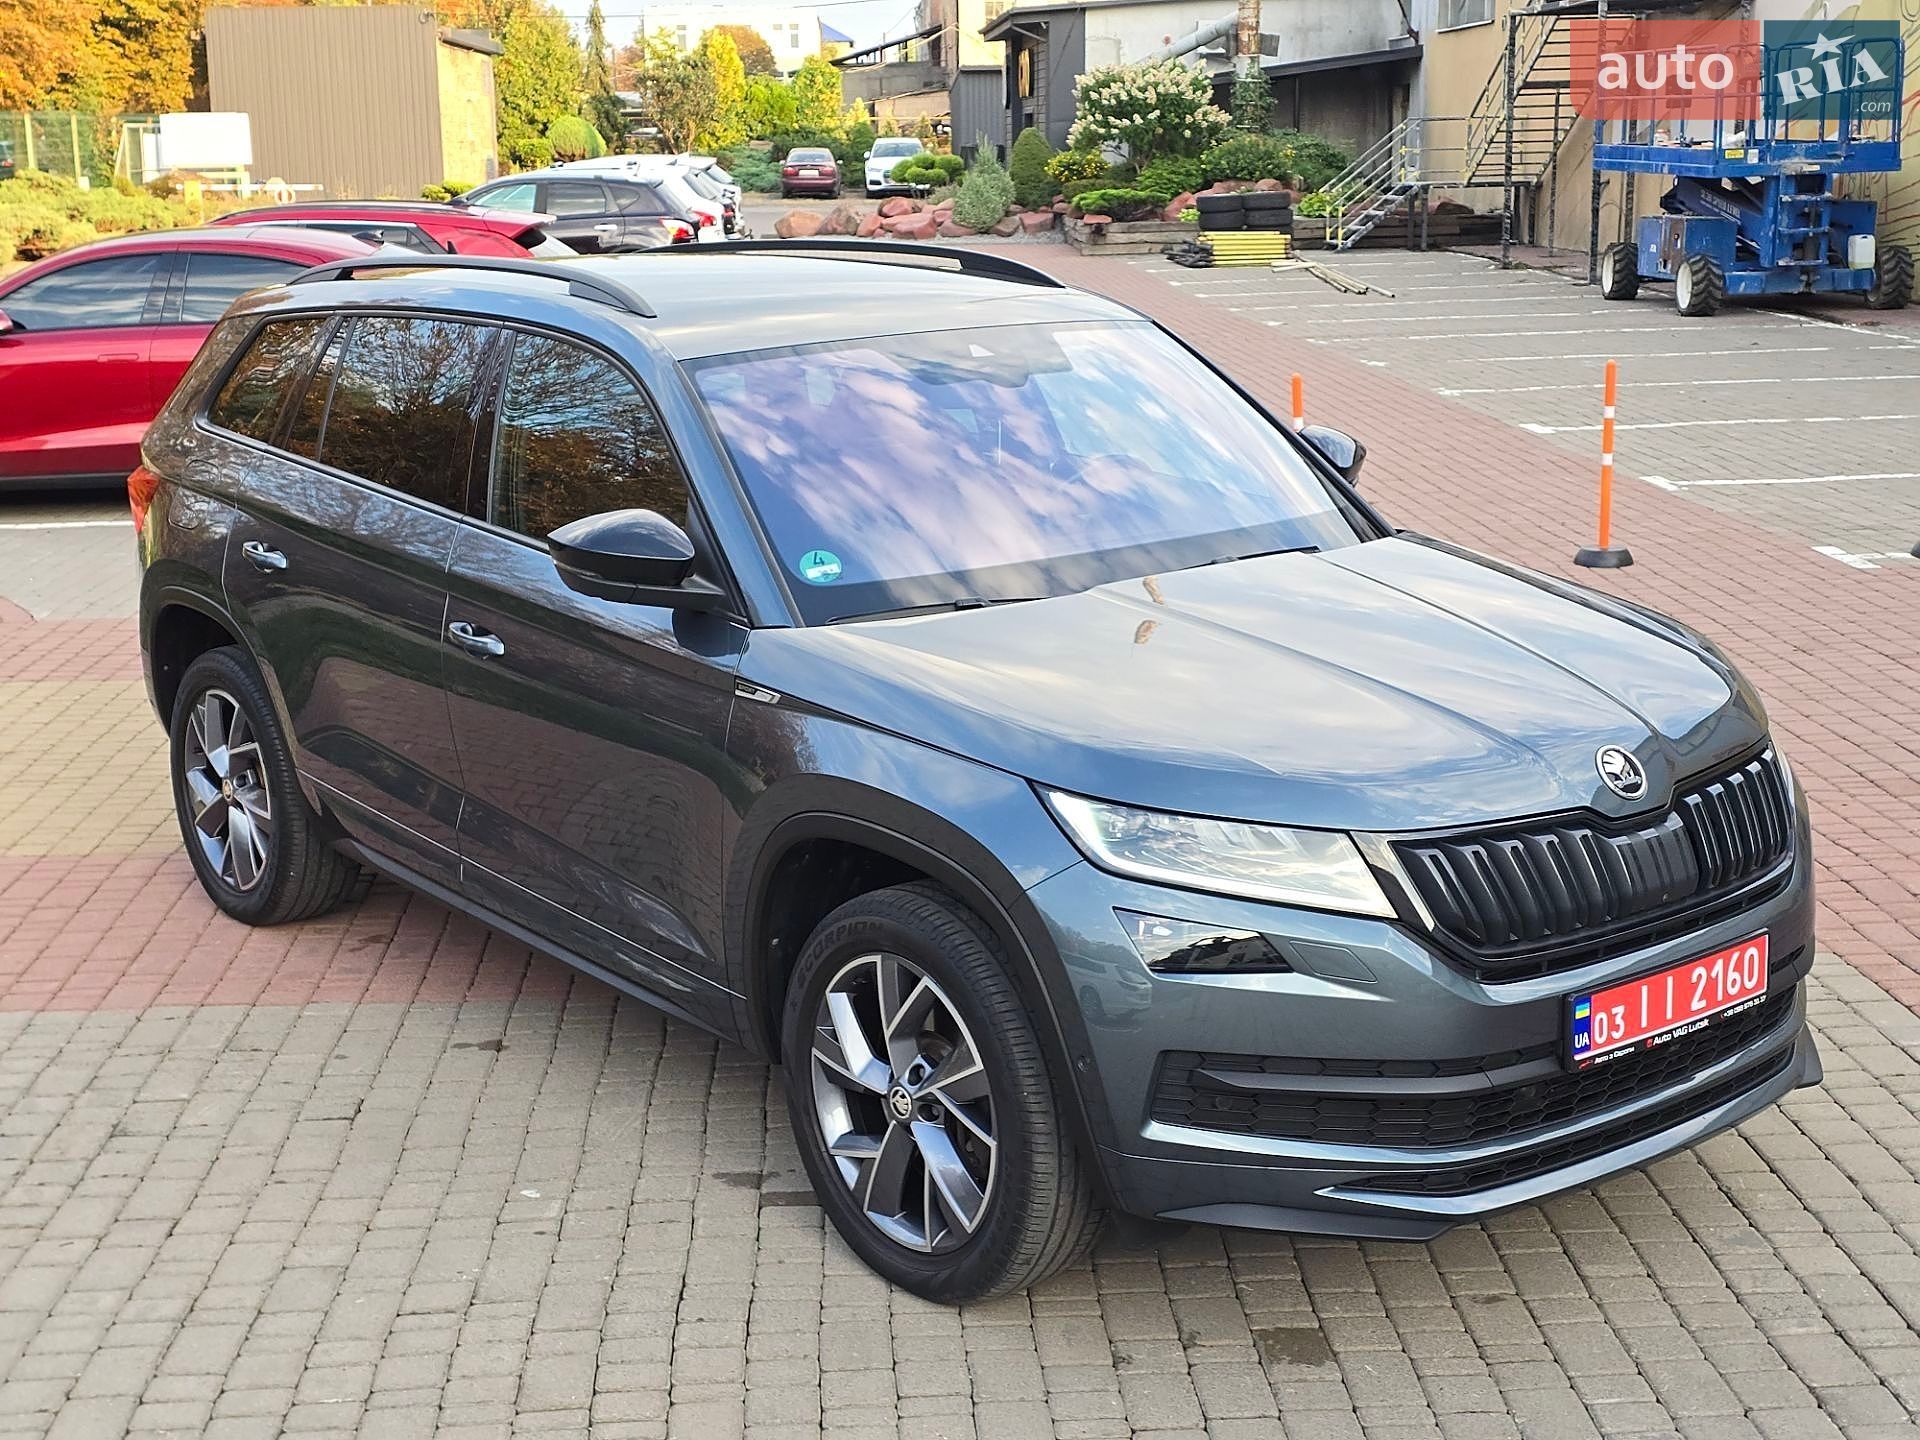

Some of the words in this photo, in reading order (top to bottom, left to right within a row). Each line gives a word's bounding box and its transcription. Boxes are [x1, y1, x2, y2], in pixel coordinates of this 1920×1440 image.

[813, 551, 825, 565] 4
[1690, 946, 1760, 1012] 2160
[1574, 1033, 1591, 1049] UA
